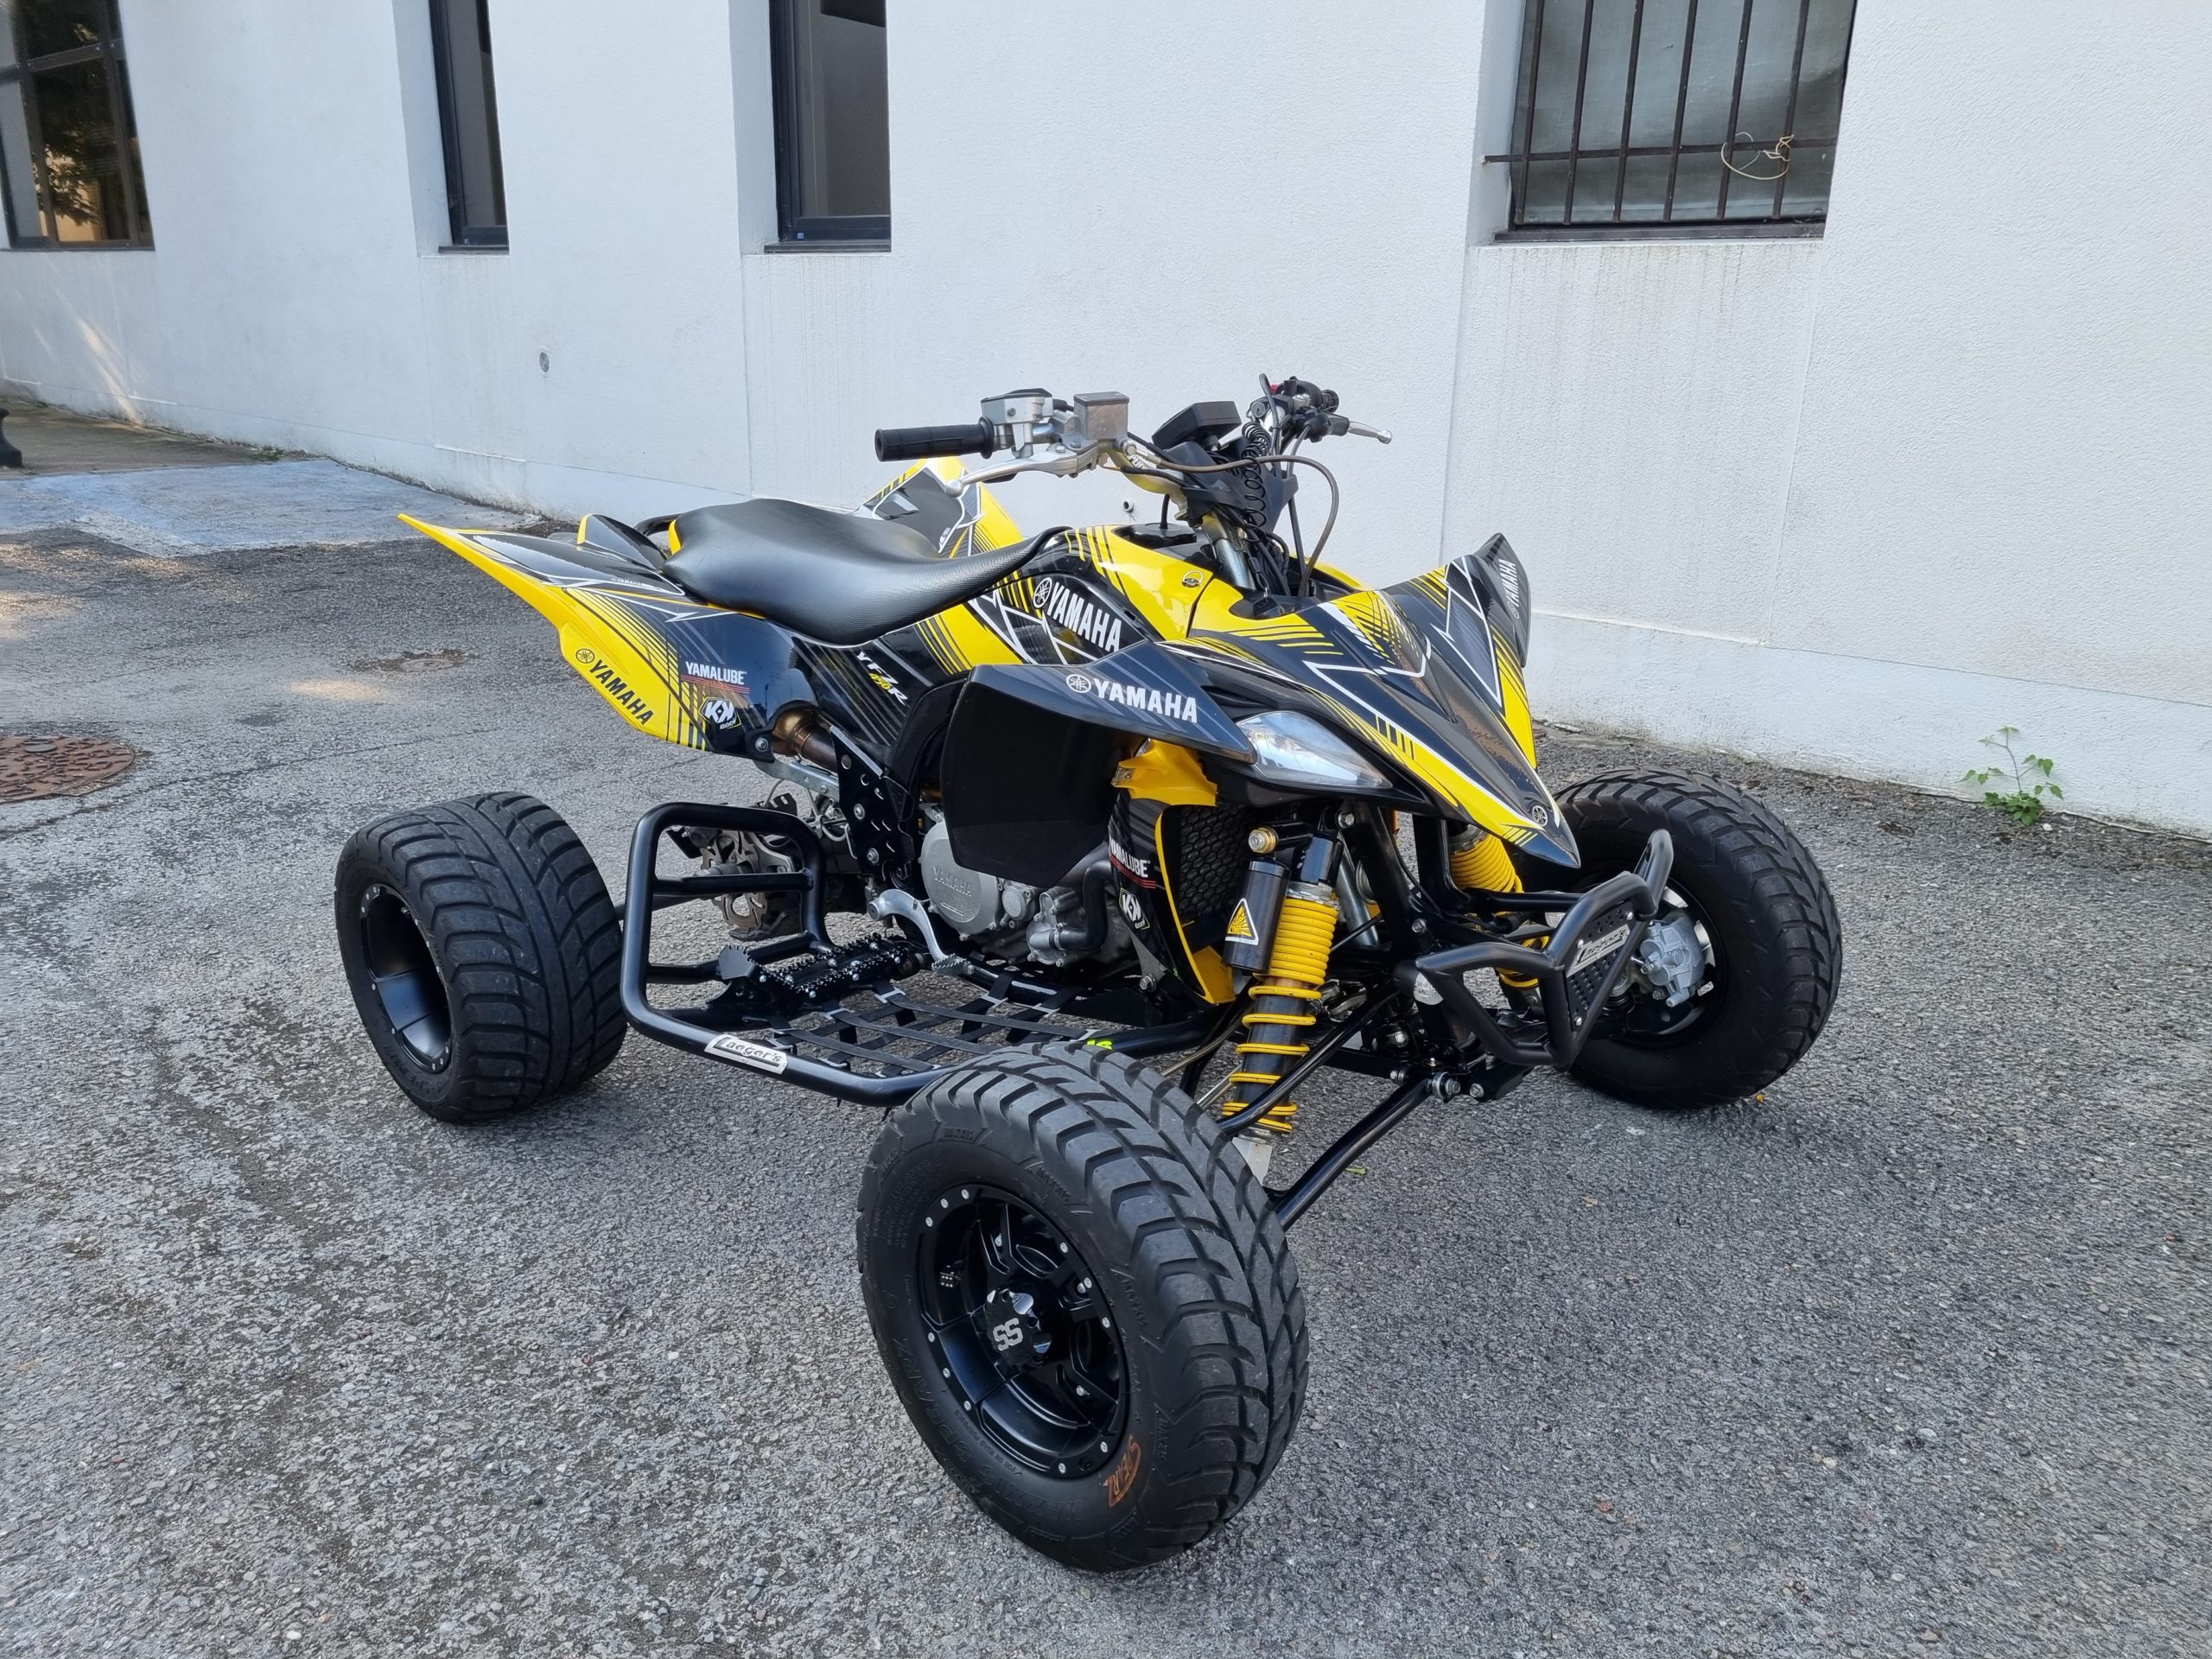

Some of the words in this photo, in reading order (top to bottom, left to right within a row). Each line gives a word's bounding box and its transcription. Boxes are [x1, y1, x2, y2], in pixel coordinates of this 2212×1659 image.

[1498, 558, 1519, 607] YAMAHA
[1046, 582, 1122, 652] YAMAHA
[588, 658, 655, 727] YAMAHA
[685, 661, 745, 685] YAMALUBE
[1092, 679, 1198, 724] YAMAHA
[993, 1317, 1024, 1351] SS
